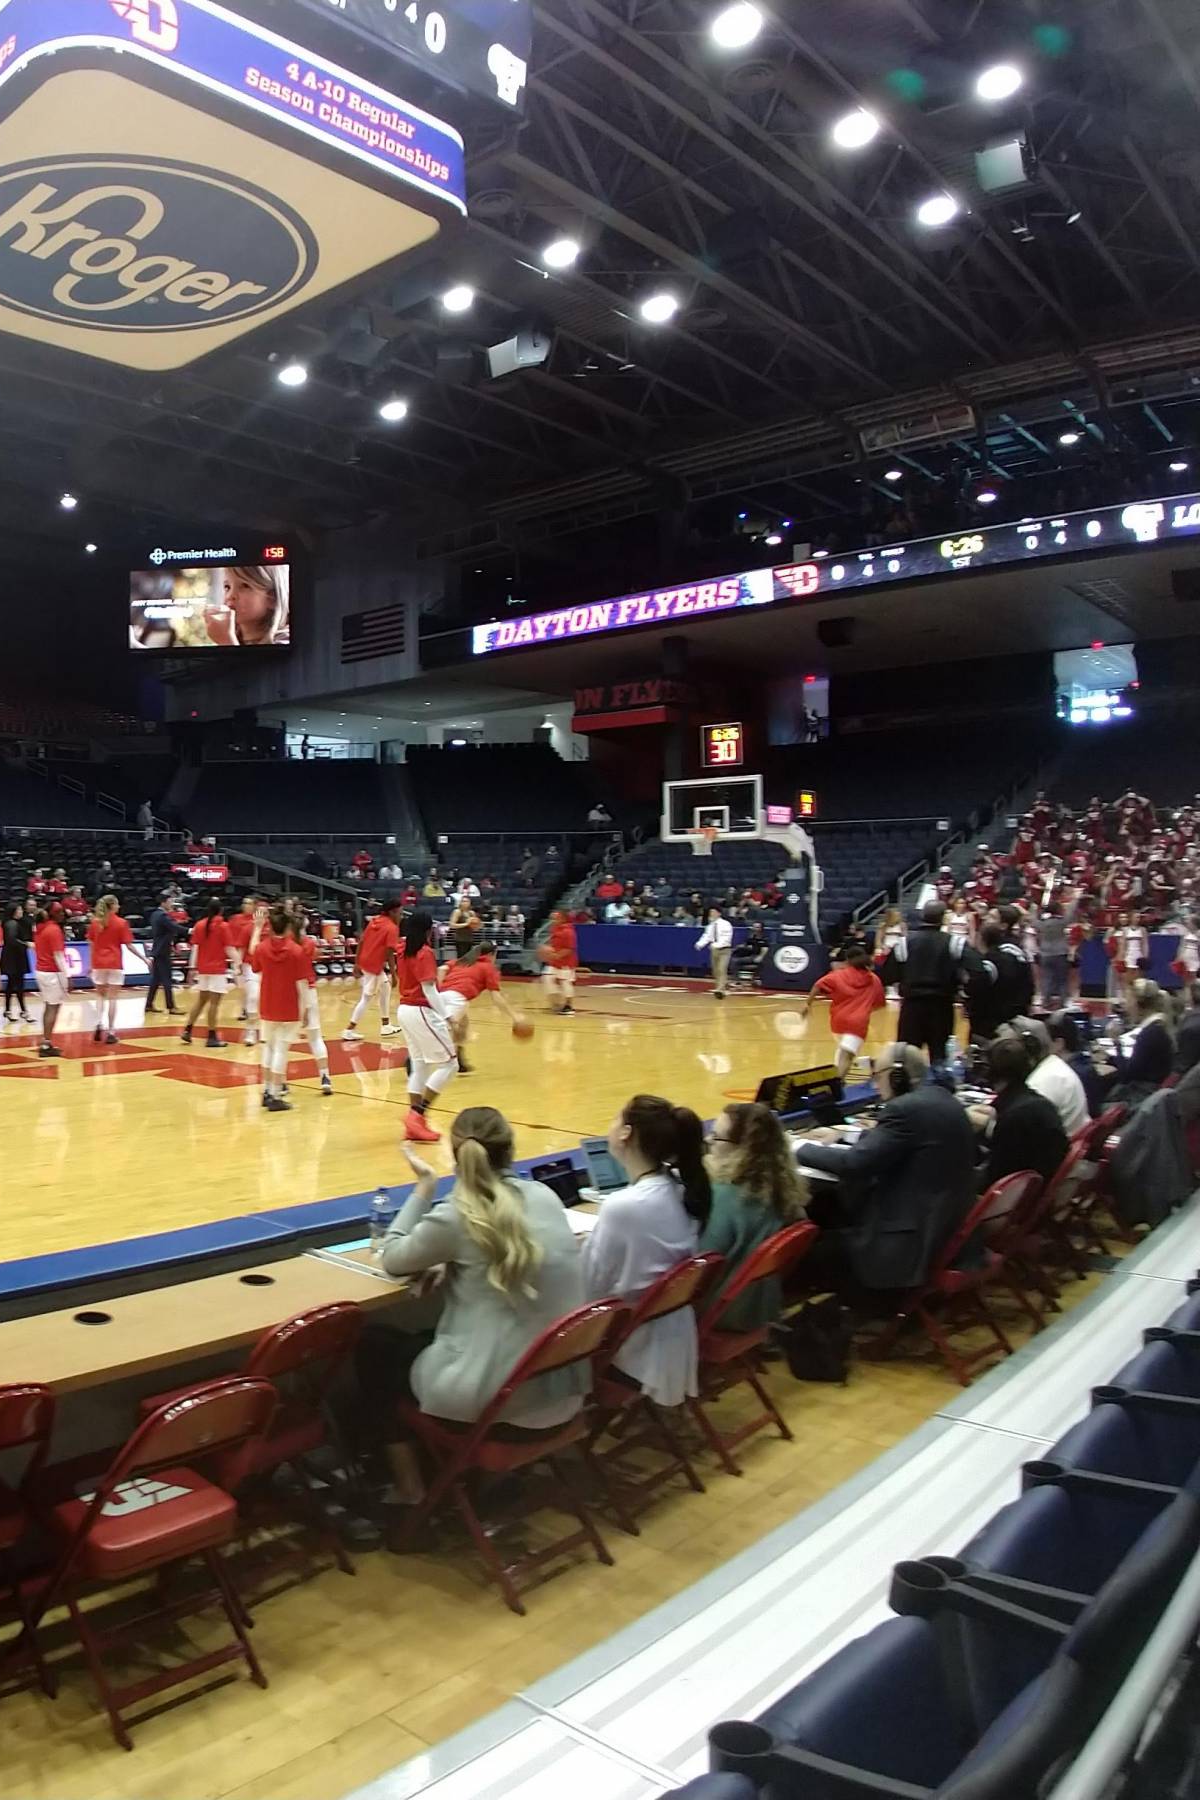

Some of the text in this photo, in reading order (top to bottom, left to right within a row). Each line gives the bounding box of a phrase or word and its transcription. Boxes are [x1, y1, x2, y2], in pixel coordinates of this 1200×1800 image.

[424, 12, 446, 53] 0
[285, 62, 416, 140] 4 A-10 Regular
[244, 67, 451, 182] Season Championships
[940, 535, 984, 558] 6:26
[1025, 535, 1039, 550] 0
[1054, 531, 1067, 546] 4
[167, 547, 237, 560] Premier Health
[862, 564, 874, 578] 4
[494, 578, 739, 645] DAYTON FLYERS
[711, 741, 737, 762] 30
